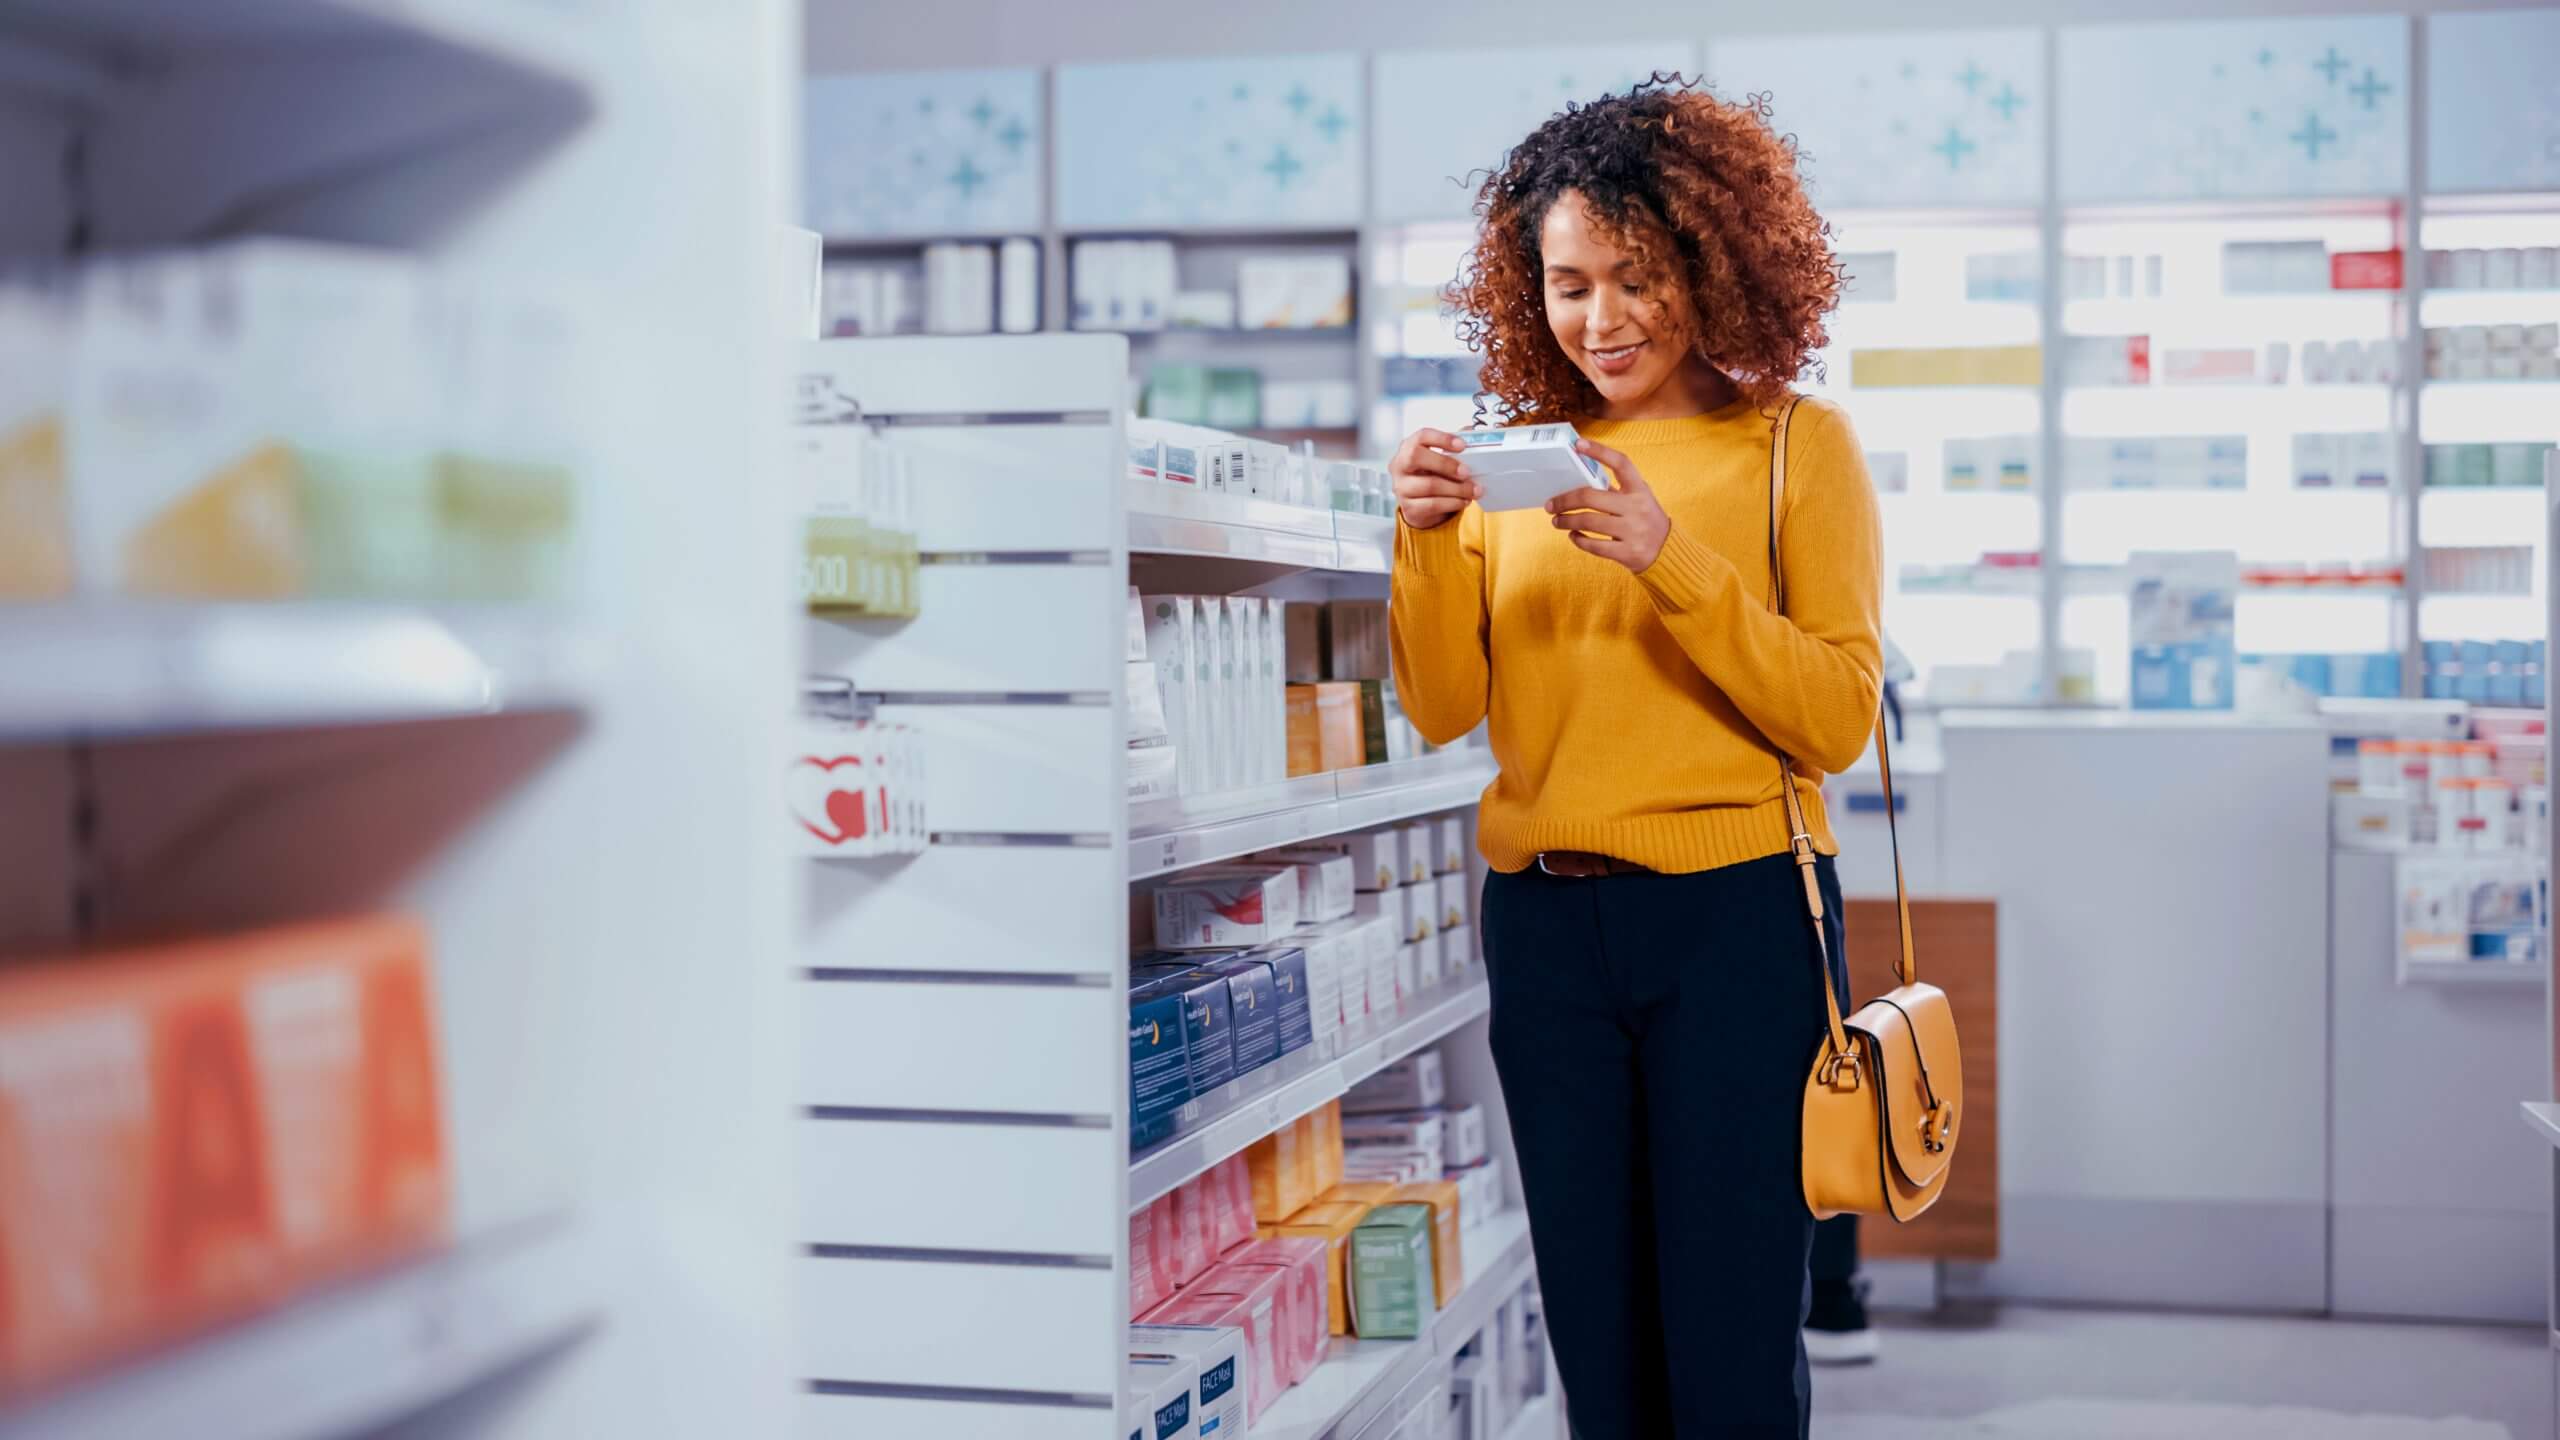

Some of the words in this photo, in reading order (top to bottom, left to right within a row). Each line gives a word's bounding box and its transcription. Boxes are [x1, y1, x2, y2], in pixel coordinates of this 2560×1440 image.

[1202, 1369, 1219, 1393] FACE
[1218, 1361, 1232, 1384] Mask
[1156, 1406, 1173, 1430] FACE
